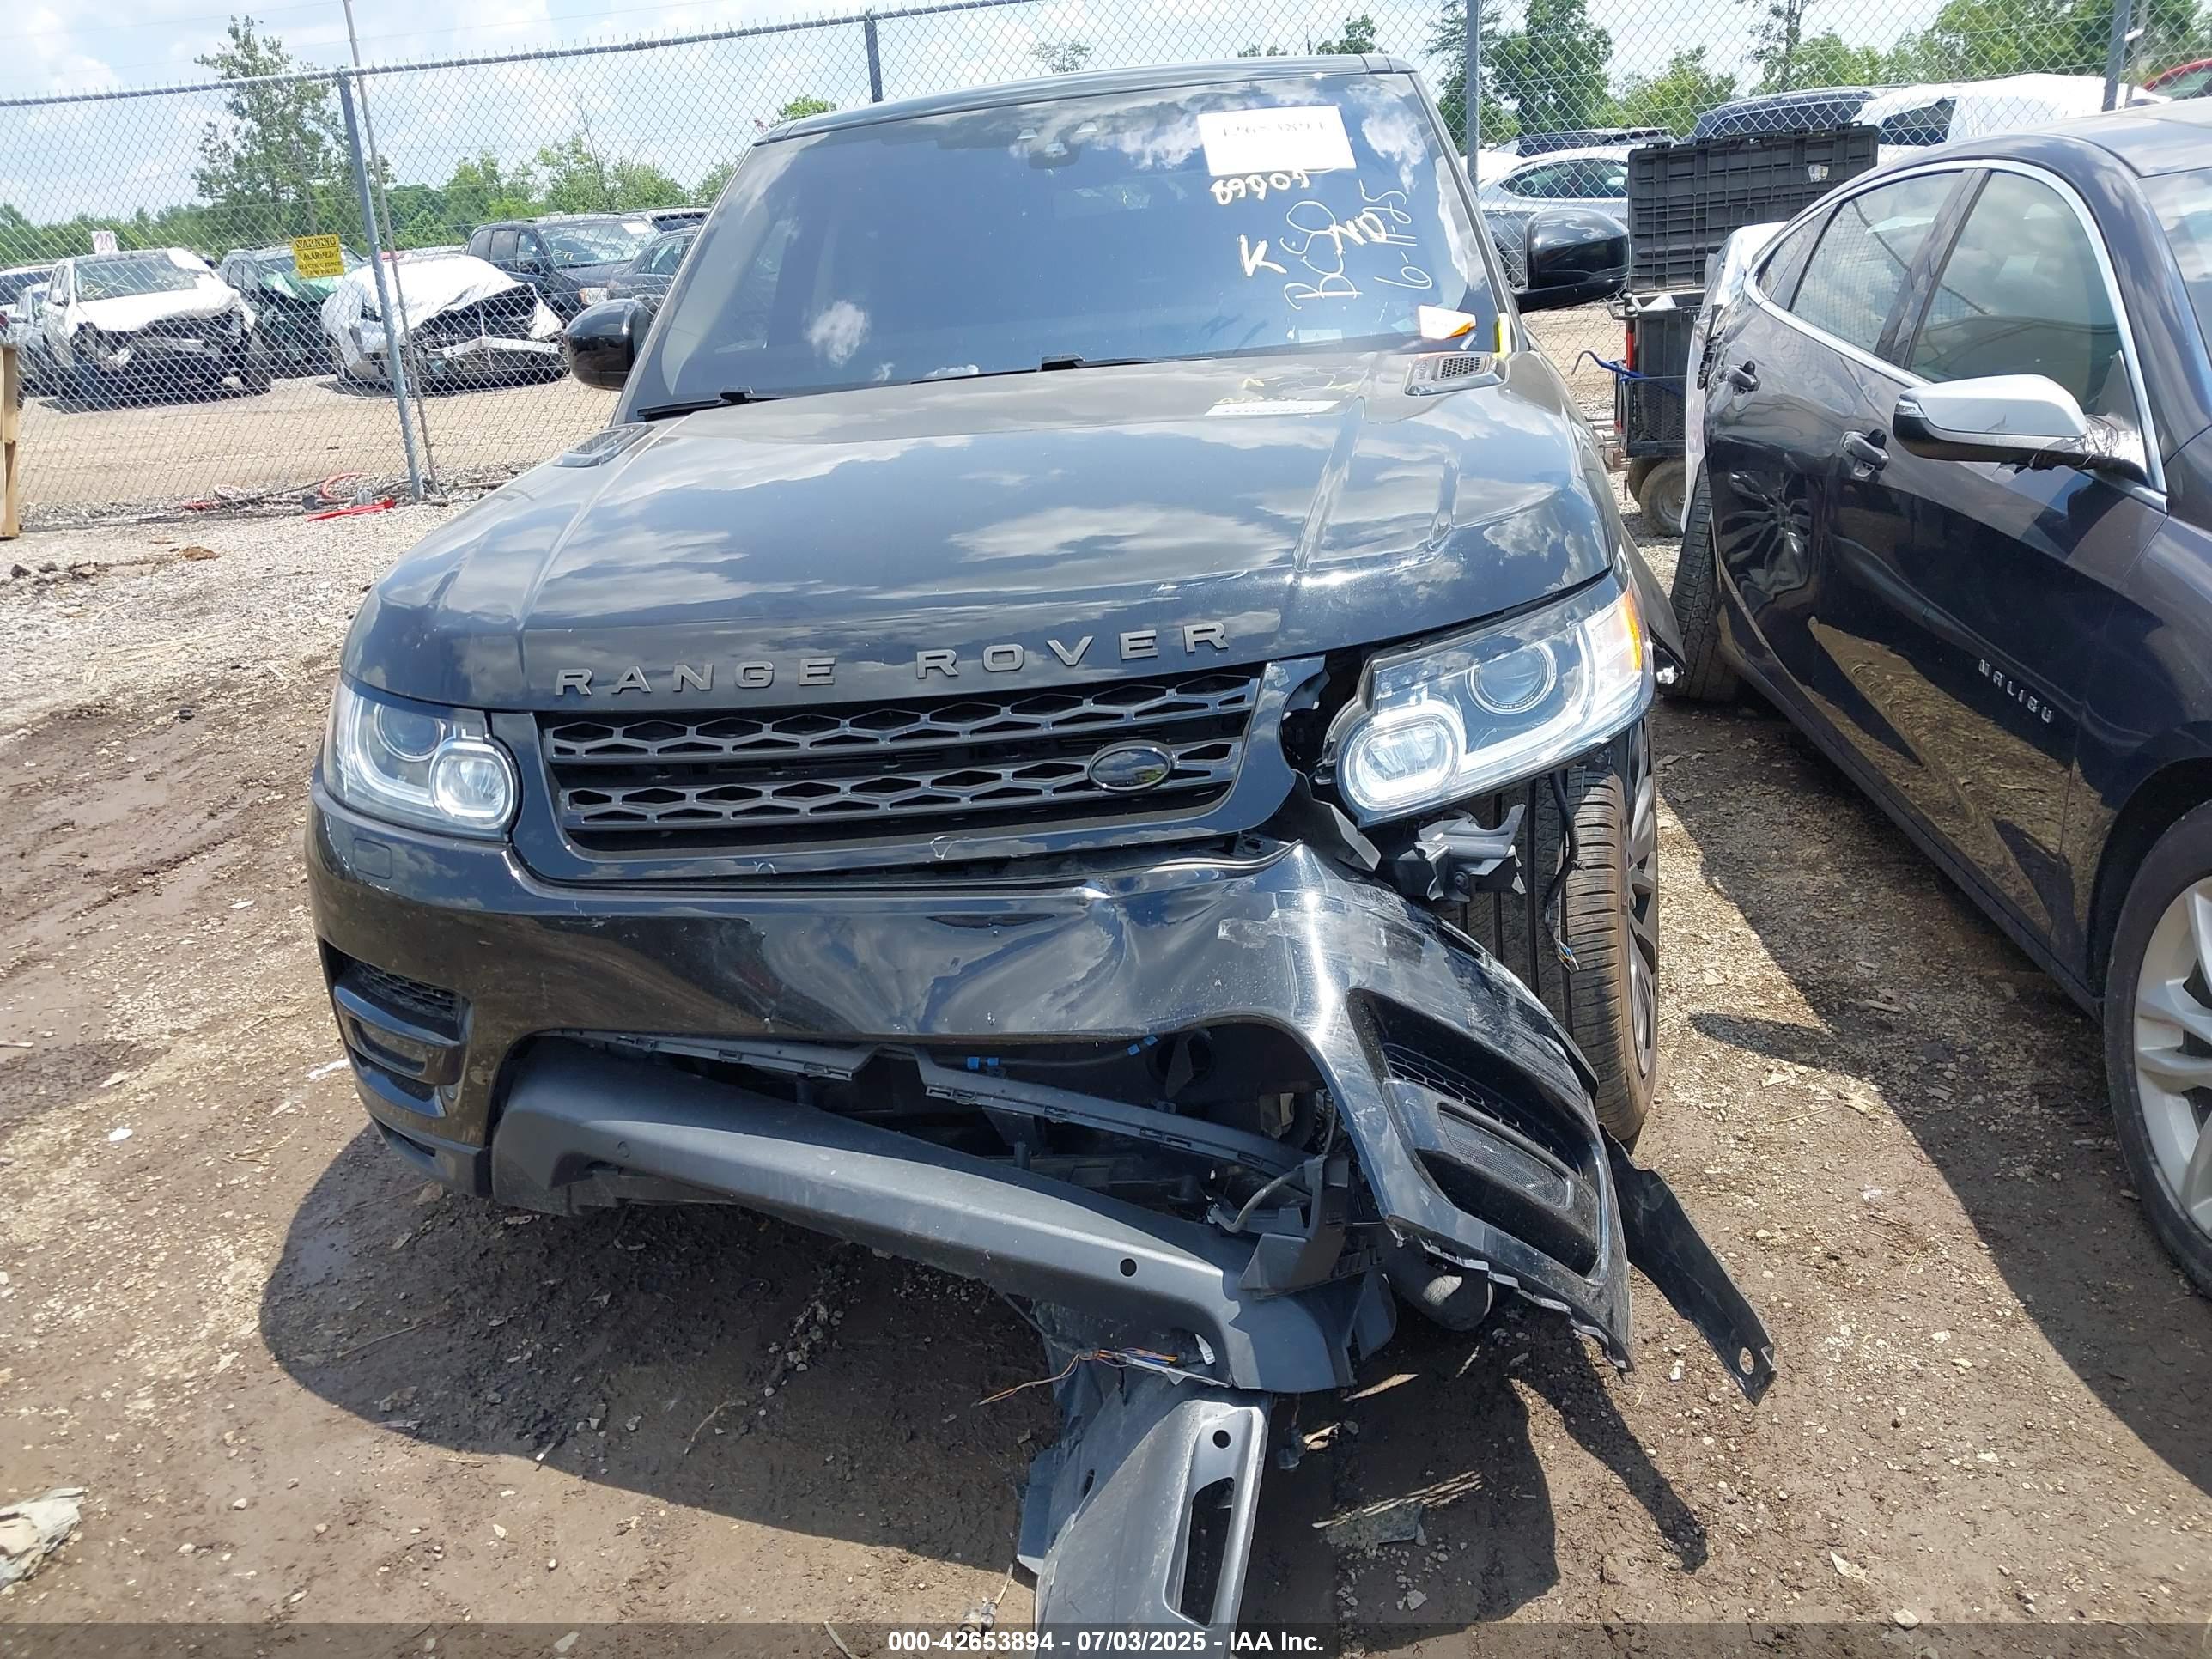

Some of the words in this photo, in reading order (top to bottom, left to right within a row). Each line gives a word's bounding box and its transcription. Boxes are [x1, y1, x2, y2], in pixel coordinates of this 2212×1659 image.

[555, 656, 837, 697] RANGE
[915, 622, 1230, 680] ROVER
[1978, 659, 2055, 724] MALIBU
